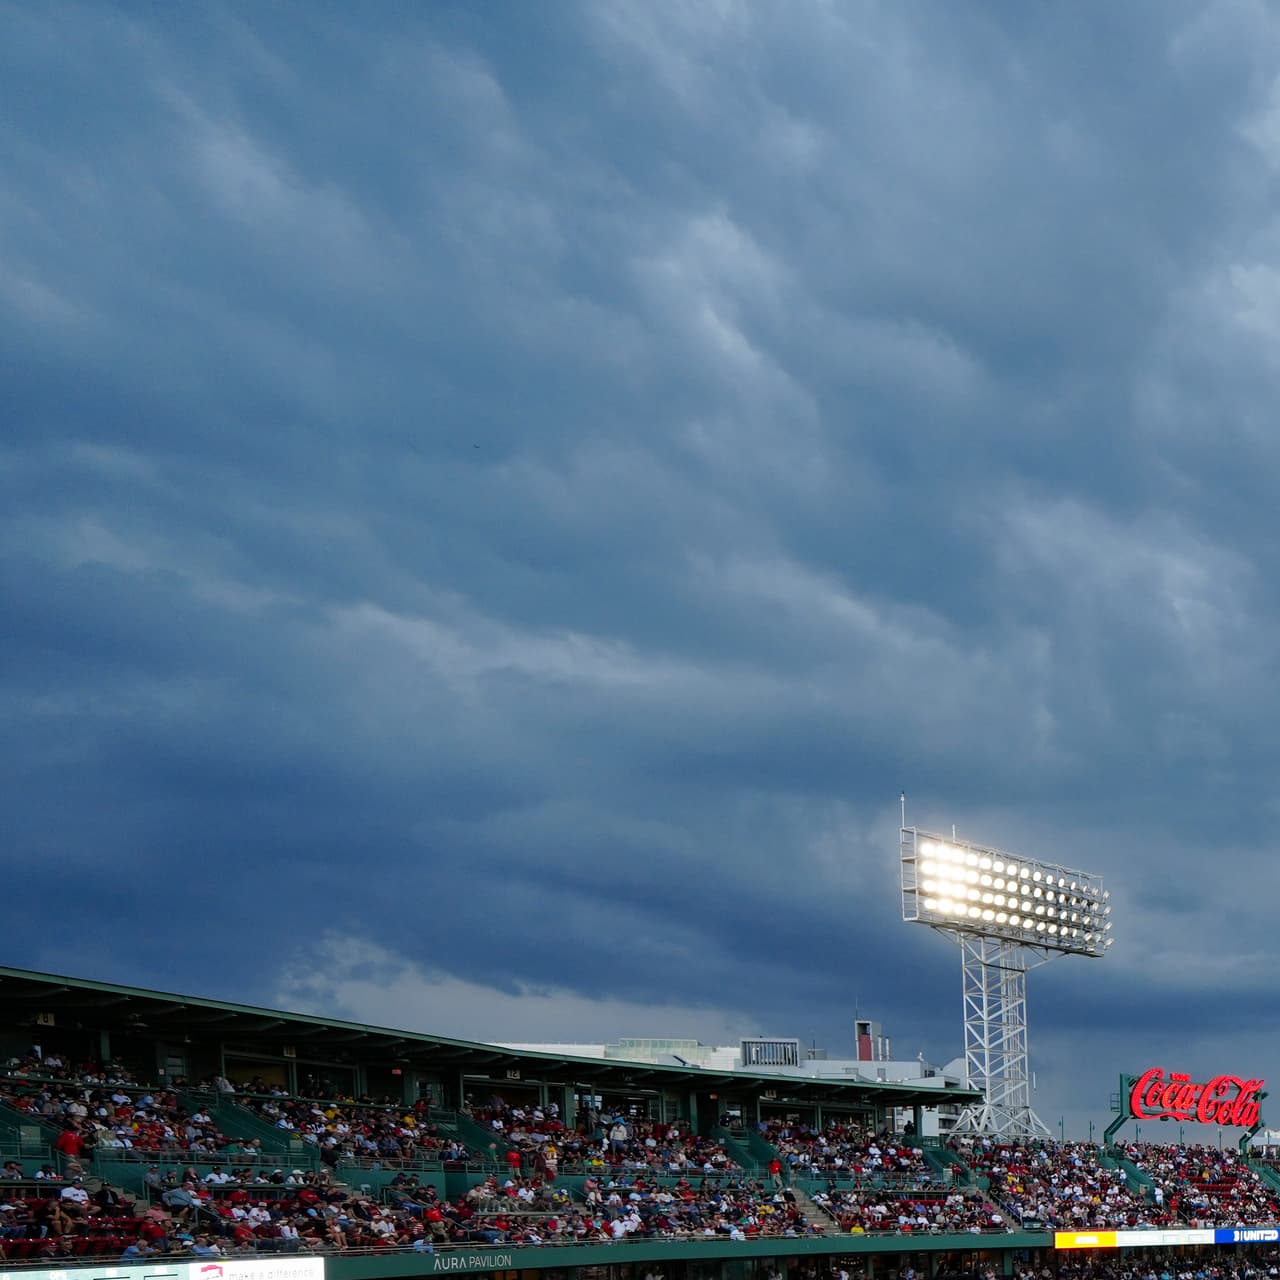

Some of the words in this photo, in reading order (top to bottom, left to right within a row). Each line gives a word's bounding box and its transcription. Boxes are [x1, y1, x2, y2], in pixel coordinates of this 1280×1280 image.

[1130, 1066, 1264, 1127] Coca-Cola
[469, 1255, 511, 1269] PAVILION
[229, 1271, 251, 1280] make
[268, 1267, 315, 1280] difference
